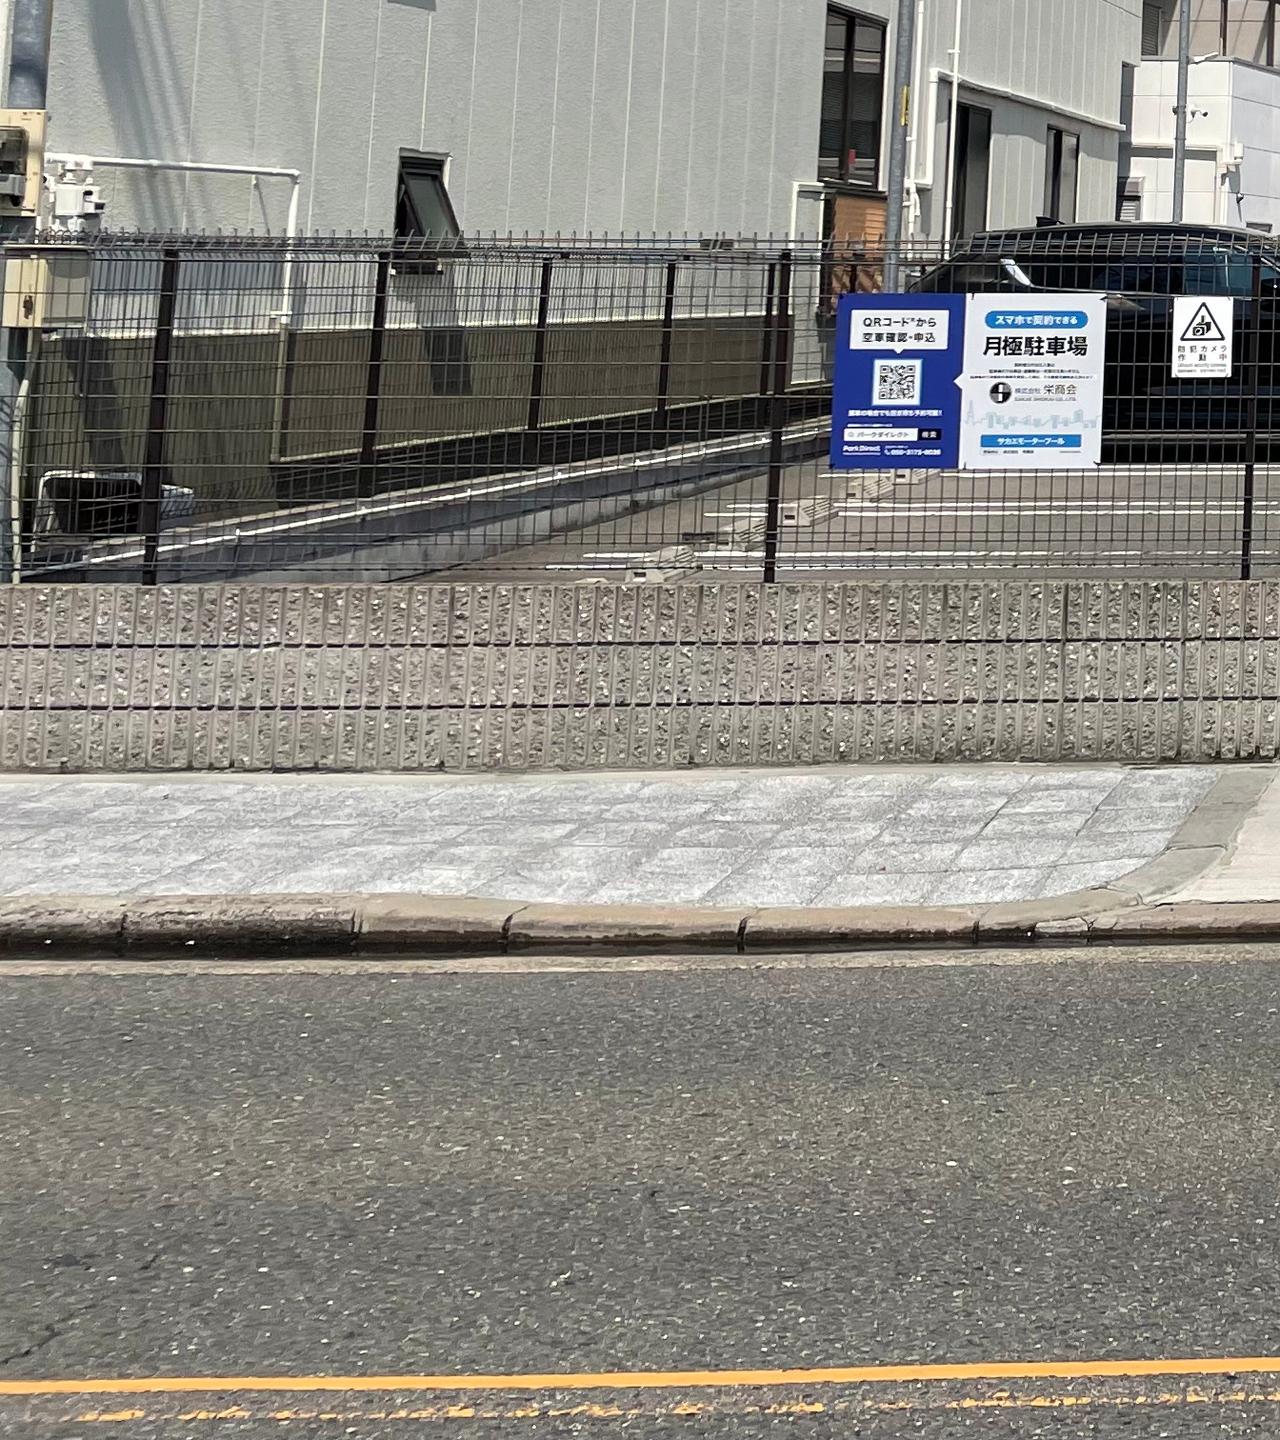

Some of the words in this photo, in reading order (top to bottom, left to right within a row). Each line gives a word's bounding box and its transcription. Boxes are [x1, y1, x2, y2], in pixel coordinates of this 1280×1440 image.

[995, 315, 1078, 325] スマホで契約できる
[983, 336, 1088, 356] 月極駐車場
[1177, 345, 1227, 353] 防犯カメラ
[1177, 353, 1227, 361] 作動中
[1043, 384, 1077, 395] 栄商会
